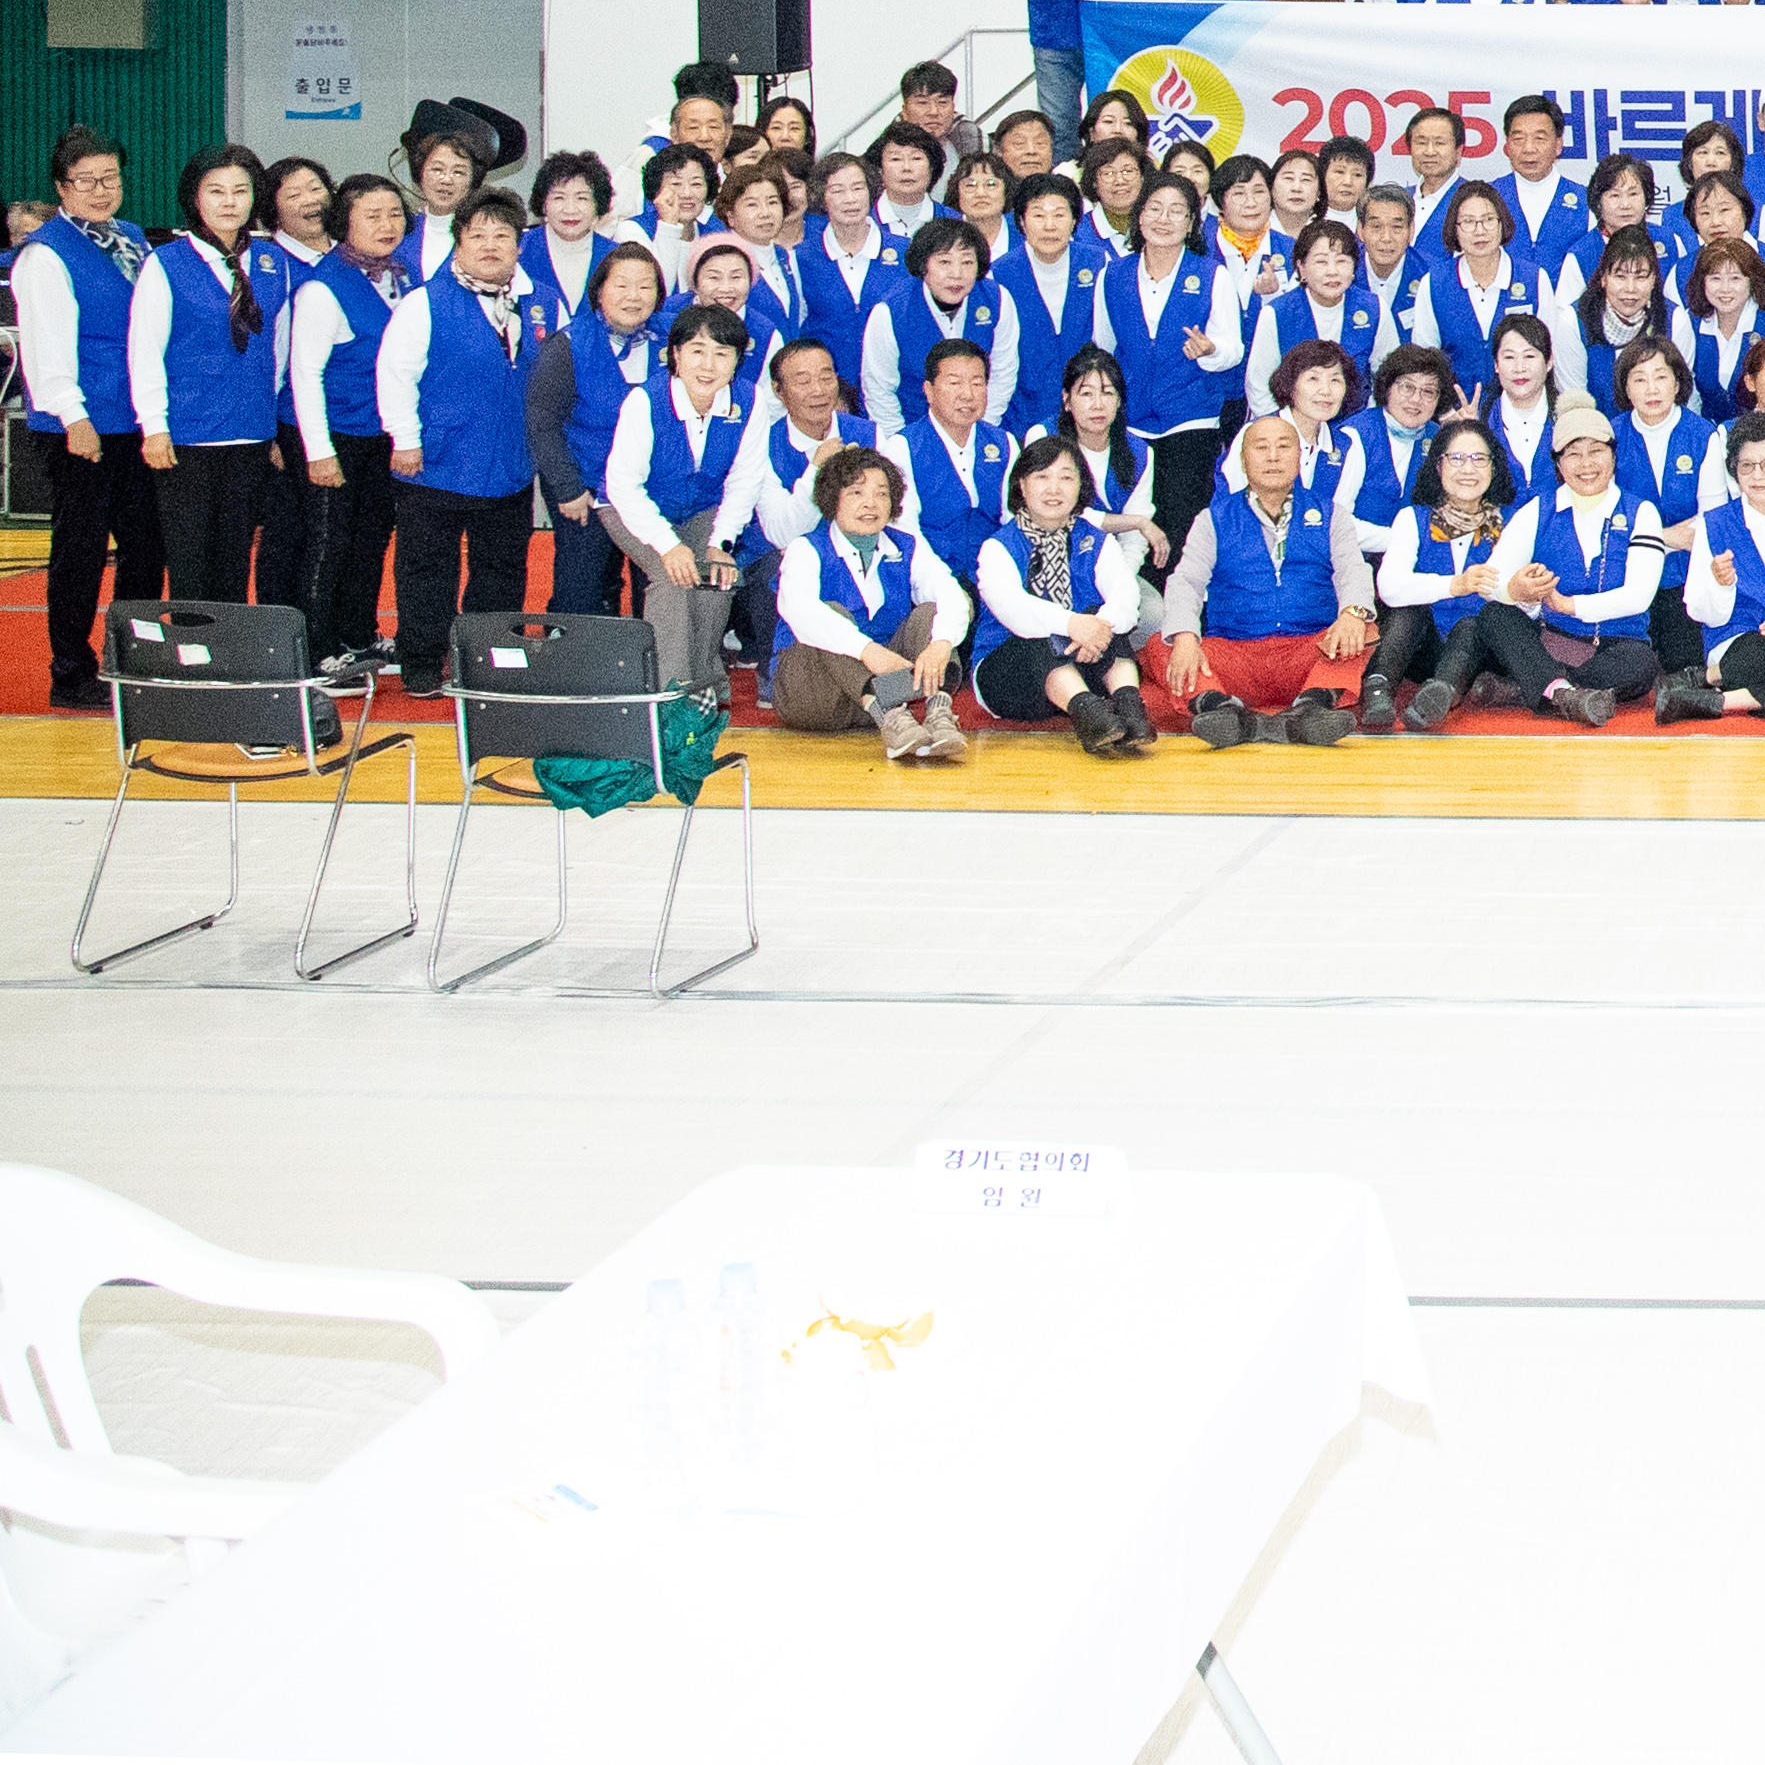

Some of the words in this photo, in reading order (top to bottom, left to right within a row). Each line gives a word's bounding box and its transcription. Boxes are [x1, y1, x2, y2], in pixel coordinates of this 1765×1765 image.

[295, 77, 352, 94] 출입문
[1271, 87, 1498, 159] 2025
[944, 1149, 1090, 1172] 경기도협의회
